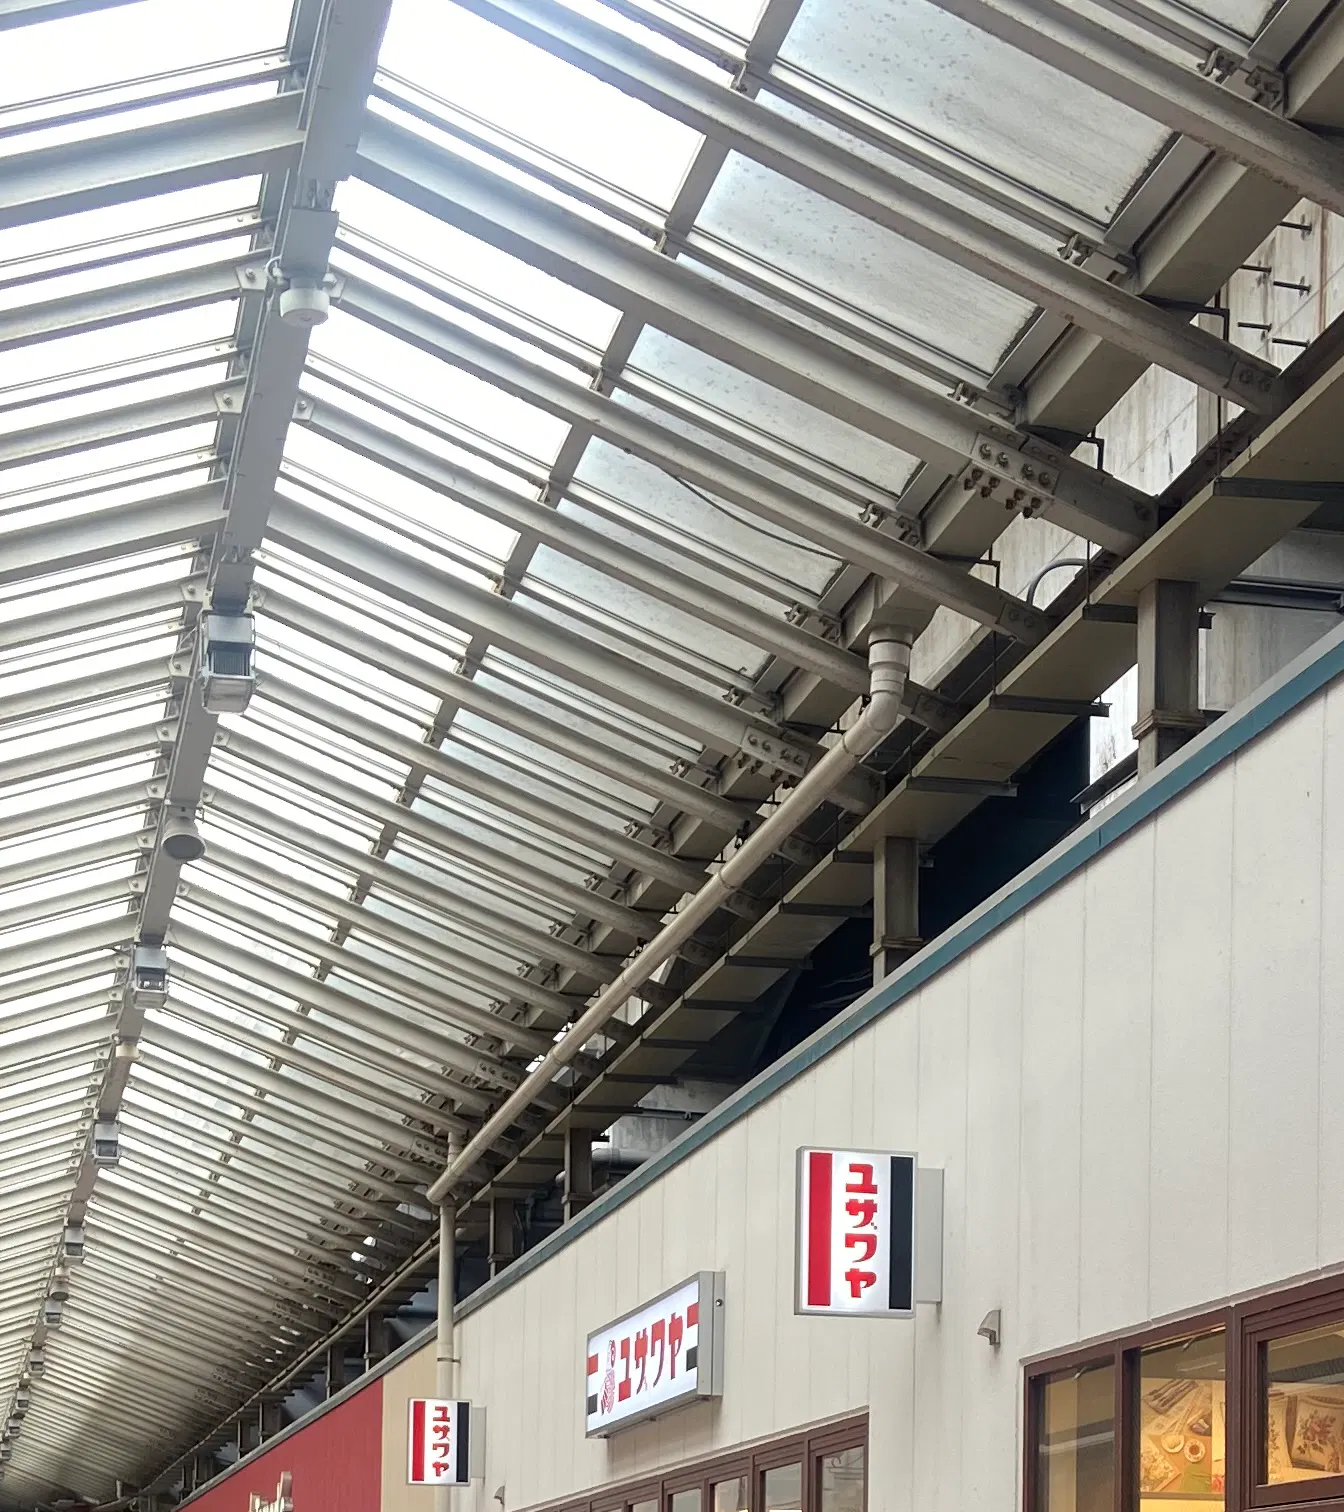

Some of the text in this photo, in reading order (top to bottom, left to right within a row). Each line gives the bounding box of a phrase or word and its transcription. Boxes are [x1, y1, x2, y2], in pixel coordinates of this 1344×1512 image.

[845, 1163, 878, 1299] ユザワヤ
[618, 1314, 683, 1402] ユザワヤ
[432, 1406, 450, 1477] ユザワヤ
